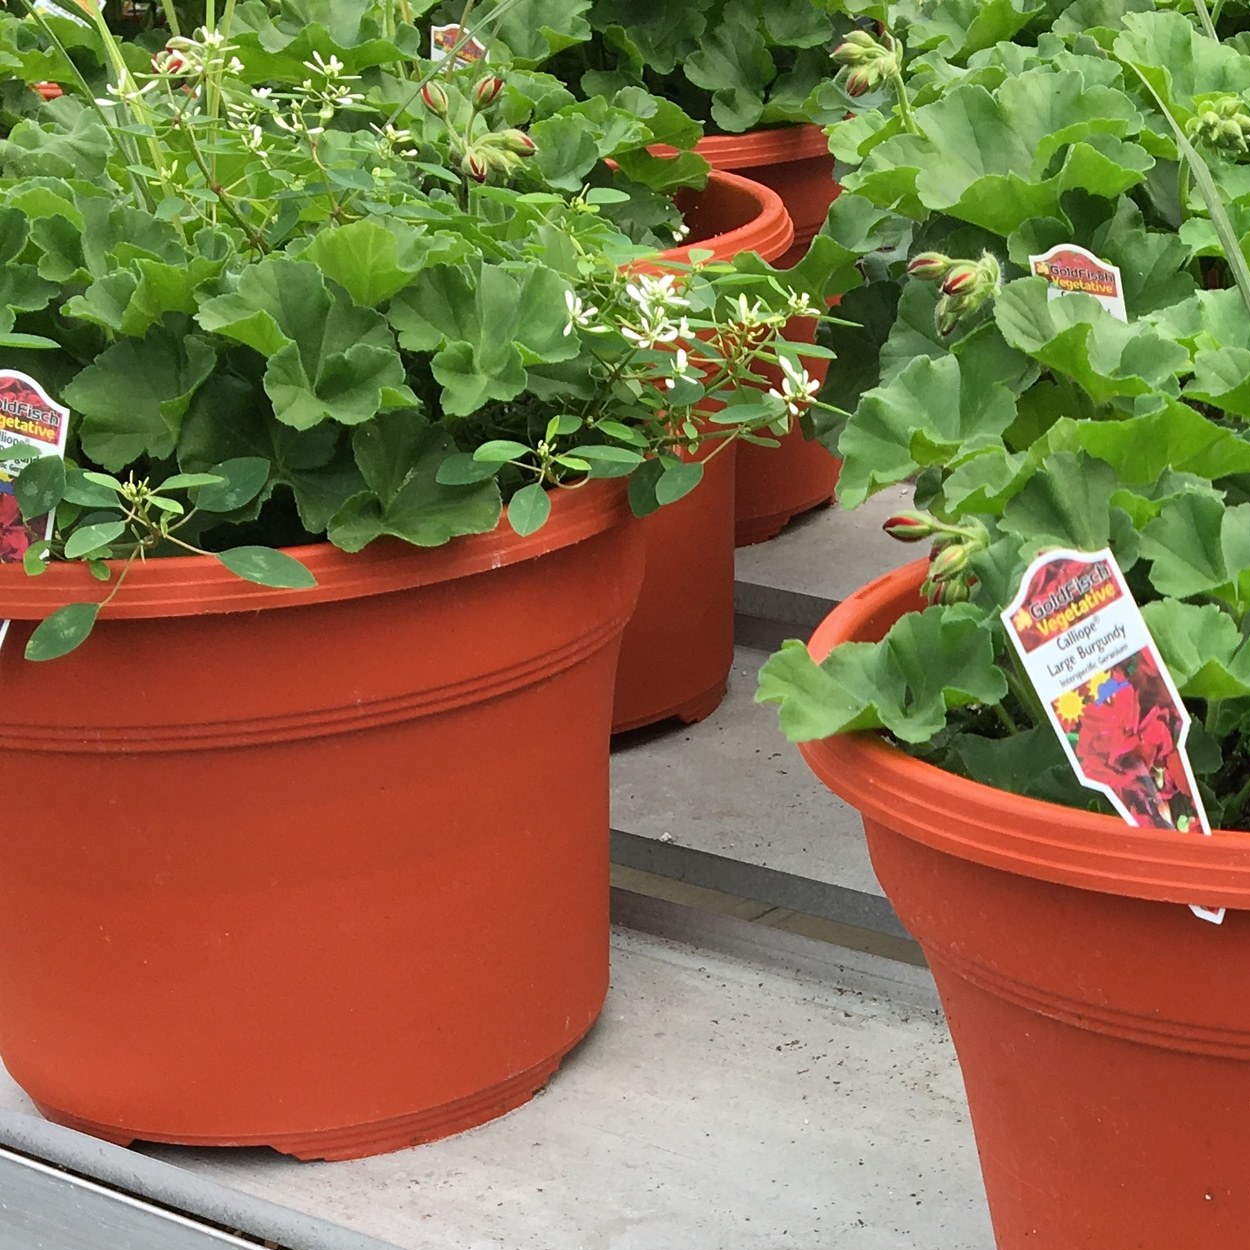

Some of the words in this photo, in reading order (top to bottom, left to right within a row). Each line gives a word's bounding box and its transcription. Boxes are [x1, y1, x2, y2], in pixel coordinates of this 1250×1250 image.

[1050, 265, 1115, 283] GoldFisch
[1051, 275, 1113, 293] Vegetative
[1030, 562, 1111, 620] GoldFisch
[1036, 582, 1116, 637] Vegetative
[1047, 655, 1077, 677] Large
[1077, 623, 1126, 659] Burgundy
[1060, 661, 1098, 688] Interspecific
[1098, 643, 1129, 665] Geranium
